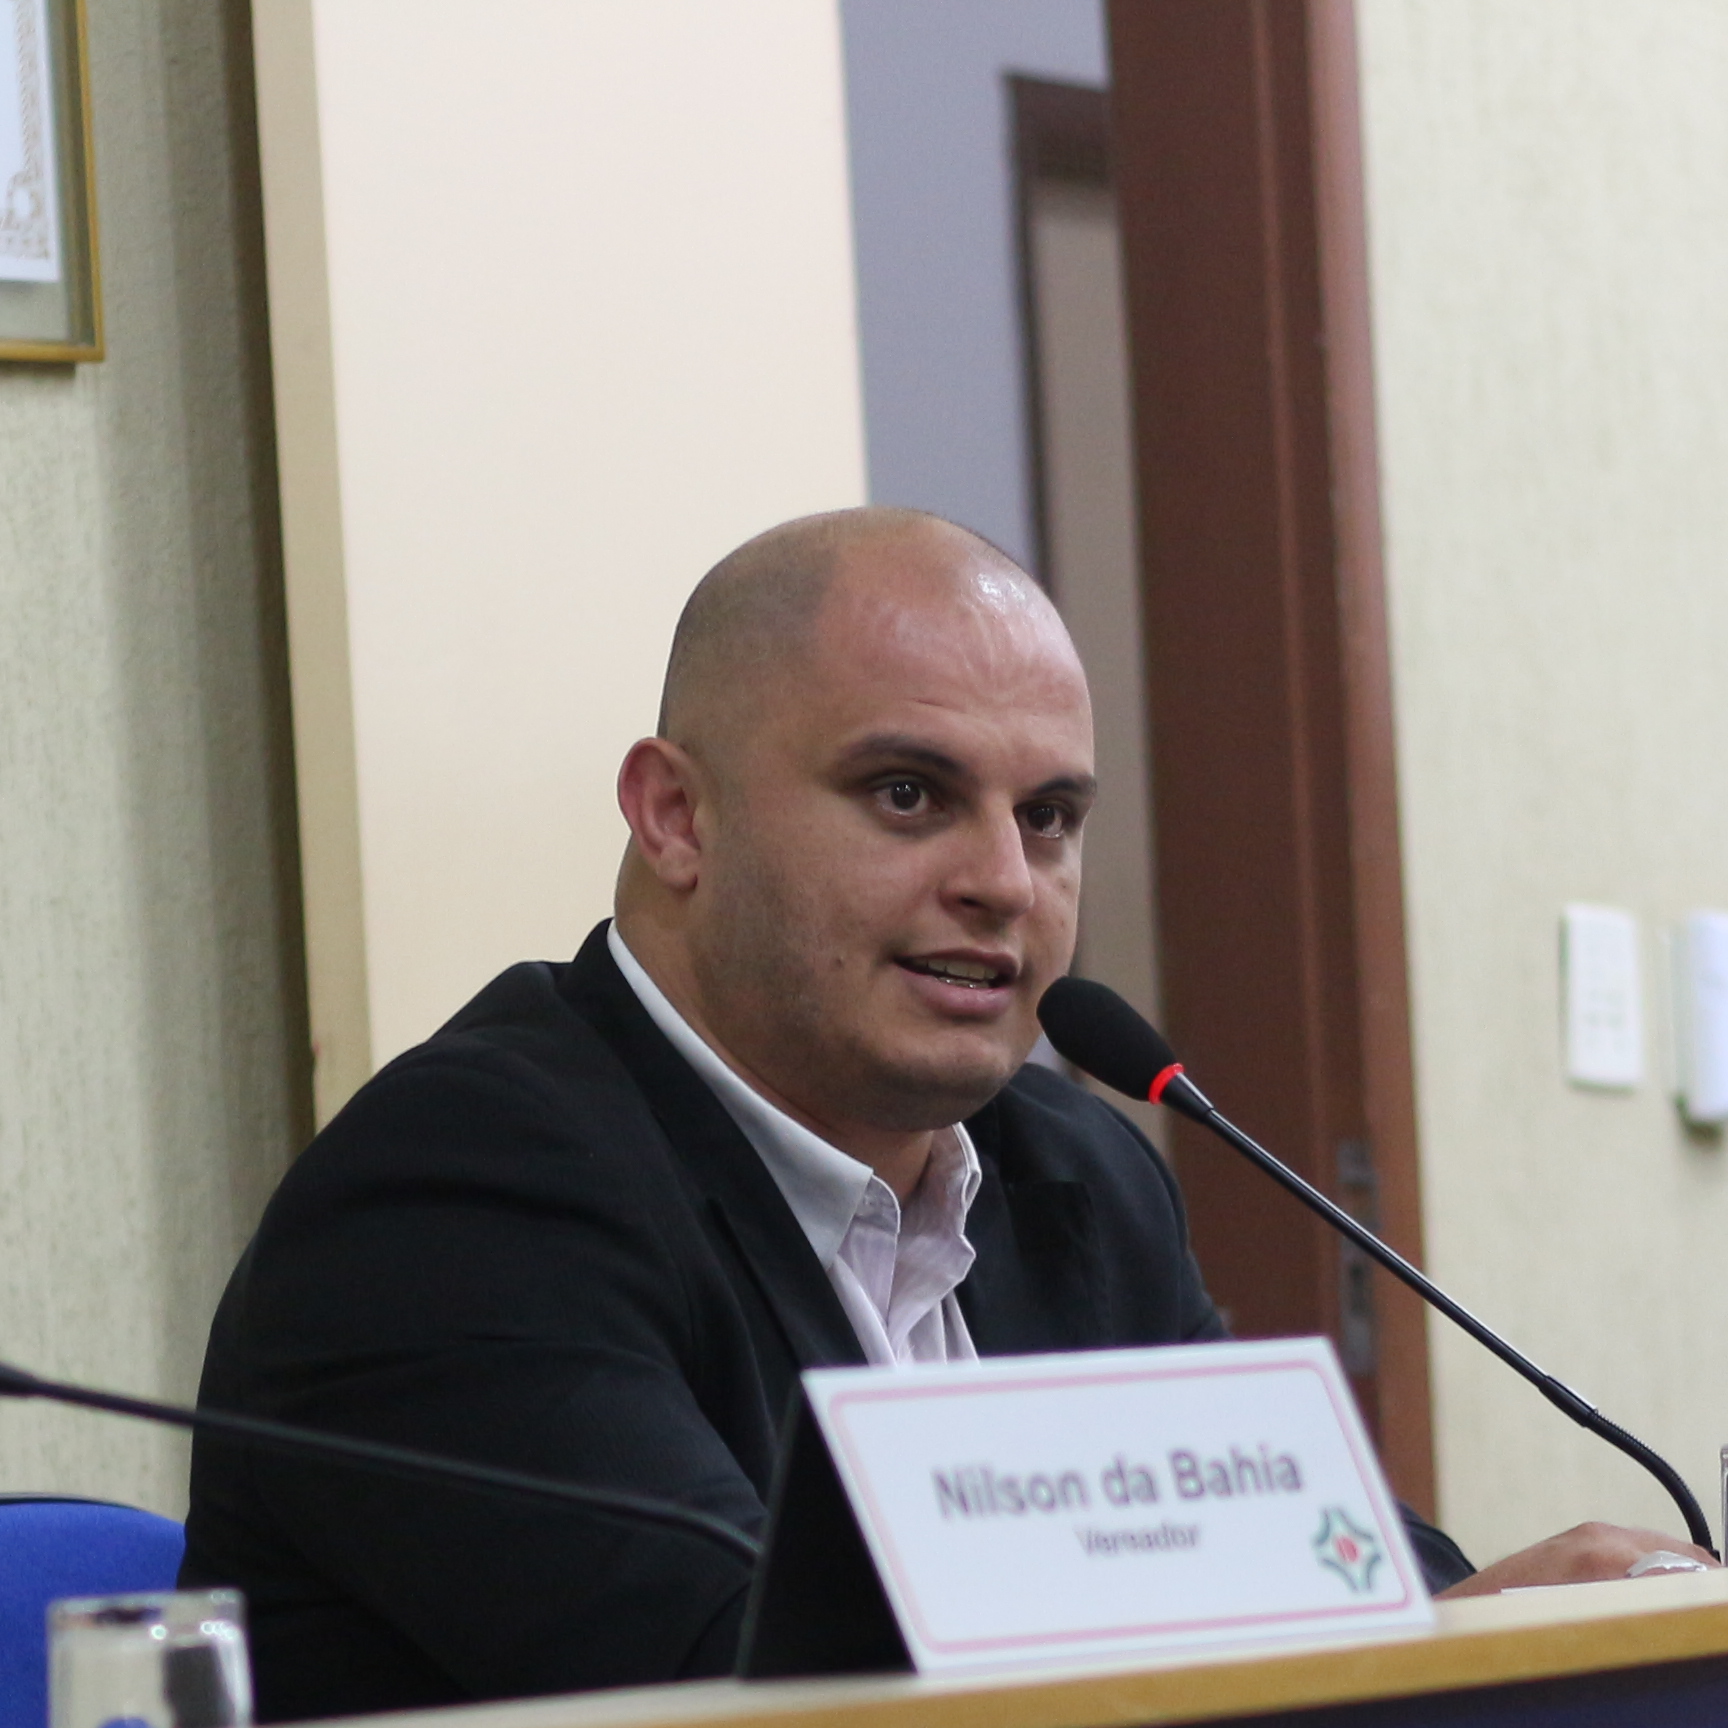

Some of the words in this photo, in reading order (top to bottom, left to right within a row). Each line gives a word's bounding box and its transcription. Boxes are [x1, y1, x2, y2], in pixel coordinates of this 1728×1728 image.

[932, 1463, 1090, 1521] Nilson
[1100, 1452, 1159, 1506] da
[1168, 1442, 1304, 1499] Bahia
[1075, 1519, 1199, 1556] Vereador
